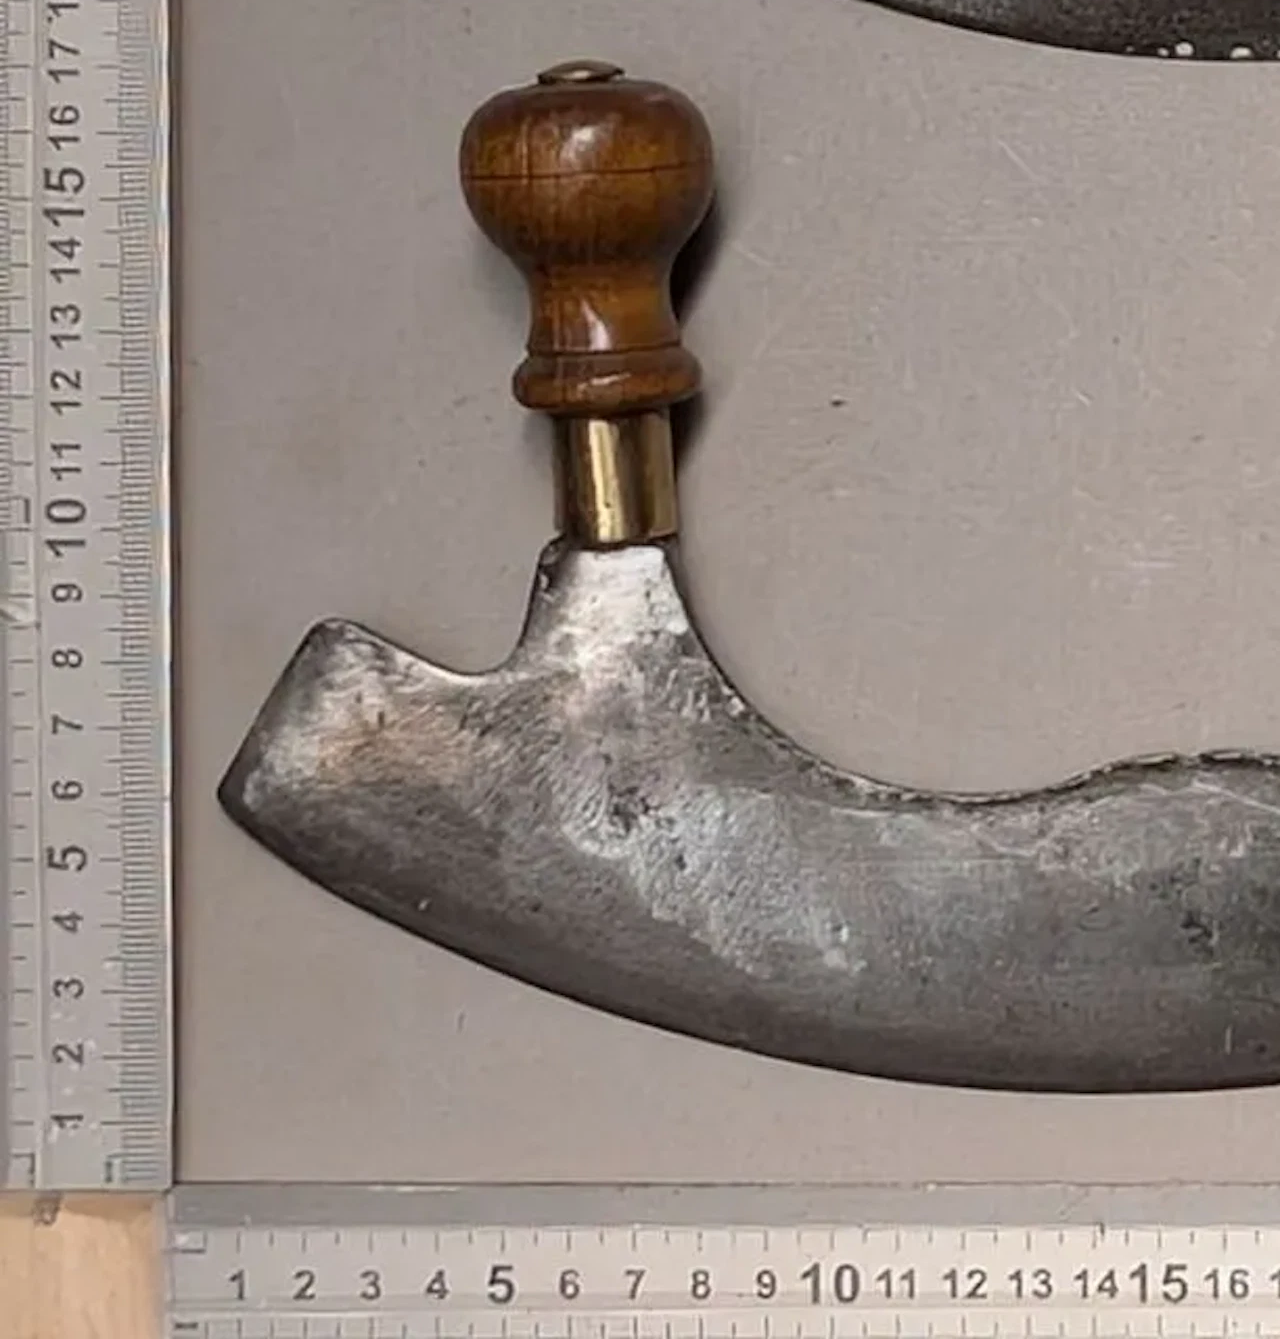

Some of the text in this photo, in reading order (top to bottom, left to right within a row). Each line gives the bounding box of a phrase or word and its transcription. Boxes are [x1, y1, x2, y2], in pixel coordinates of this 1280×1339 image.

[46, 38, 81, 84] 17
[46, 104, 81, 152] 16
[41, 166, 86, 228] 15
[47, 237, 82, 285] 14
[49, 303, 82, 350] 13
[49, 369, 83, 416] 12
[49, 442, 83, 482] 11
[43, 498, 88, 559] 10
[50, 583, 83, 604] 9
[50, 648, 84, 670] 8
[50, 714, 84, 736] 7
[50, 780, 84, 801] 6
[45, 844, 88, 873] 5
[51, 911, 85, 934] 4
[51, 977, 85, 1000] 3
[51, 1043, 84, 1066] 2
[49, 1113, 84, 1130] 1
[228, 1269, 246, 1302] 1
[292, 1269, 316, 1302] 2
[359, 1269, 382, 1302] 3
[424, 1269, 450, 1301] 4
[486, 1264, 516, 1306] 5
[558, 1268, 581, 1302] 6
[624, 1269, 646, 1301] 7
[690, 1268, 712, 1302] 8
[755, 1268, 777, 1300] 9
[799, 1261, 861, 1306] 10
[875, 1267, 916, 1301] 11
[941, 1267, 988, 1300] 12
[1007, 1267, 1054, 1301] 13
[1073, 1268, 1120, 1301] 14
[1128, 1262, 1189, 1307] 15
[1203, 1267, 1250, 1302] 16
